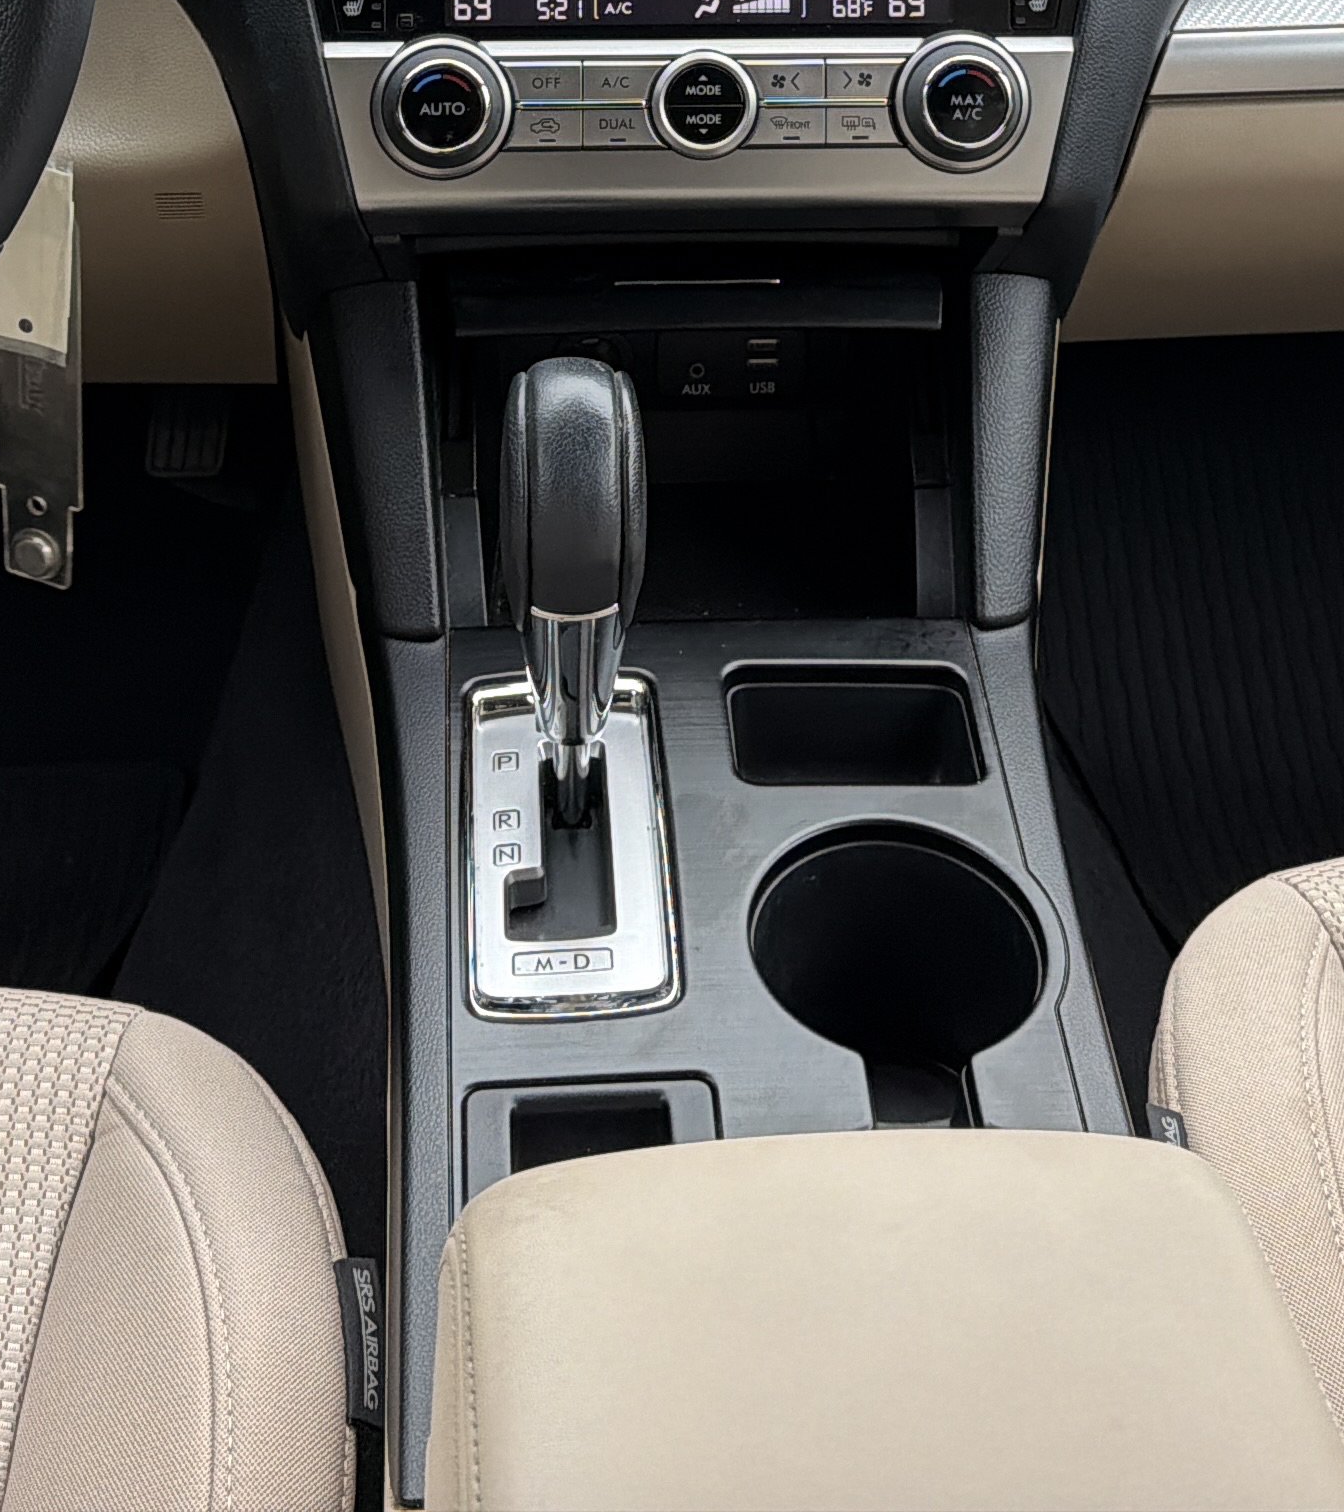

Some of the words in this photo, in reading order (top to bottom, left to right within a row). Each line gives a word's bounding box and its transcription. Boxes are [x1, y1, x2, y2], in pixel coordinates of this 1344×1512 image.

[604, 1, 633, 15] A/C
[532, 77, 561, 89] OFF
[601, 76, 630, 88] A/C
[685, 85, 722, 95] MODE
[950, 94, 984, 106] MAX
[419, 102, 465, 116] AUTO
[952, 108, 983, 121] A/C
[599, 118, 635, 130] DUAL
[786, 119, 811, 130] FRONT
[685, 114, 722, 125] MODE
[681, 383, 711, 395] AUX
[749, 381, 776, 394] USB
[497, 755, 513, 771] P
[499, 813, 512, 828] R
[499, 847, 515, 863] N
[358, 1268, 376, 1313] SRS
[365, 1316, 379, 1411] AIRBAG
